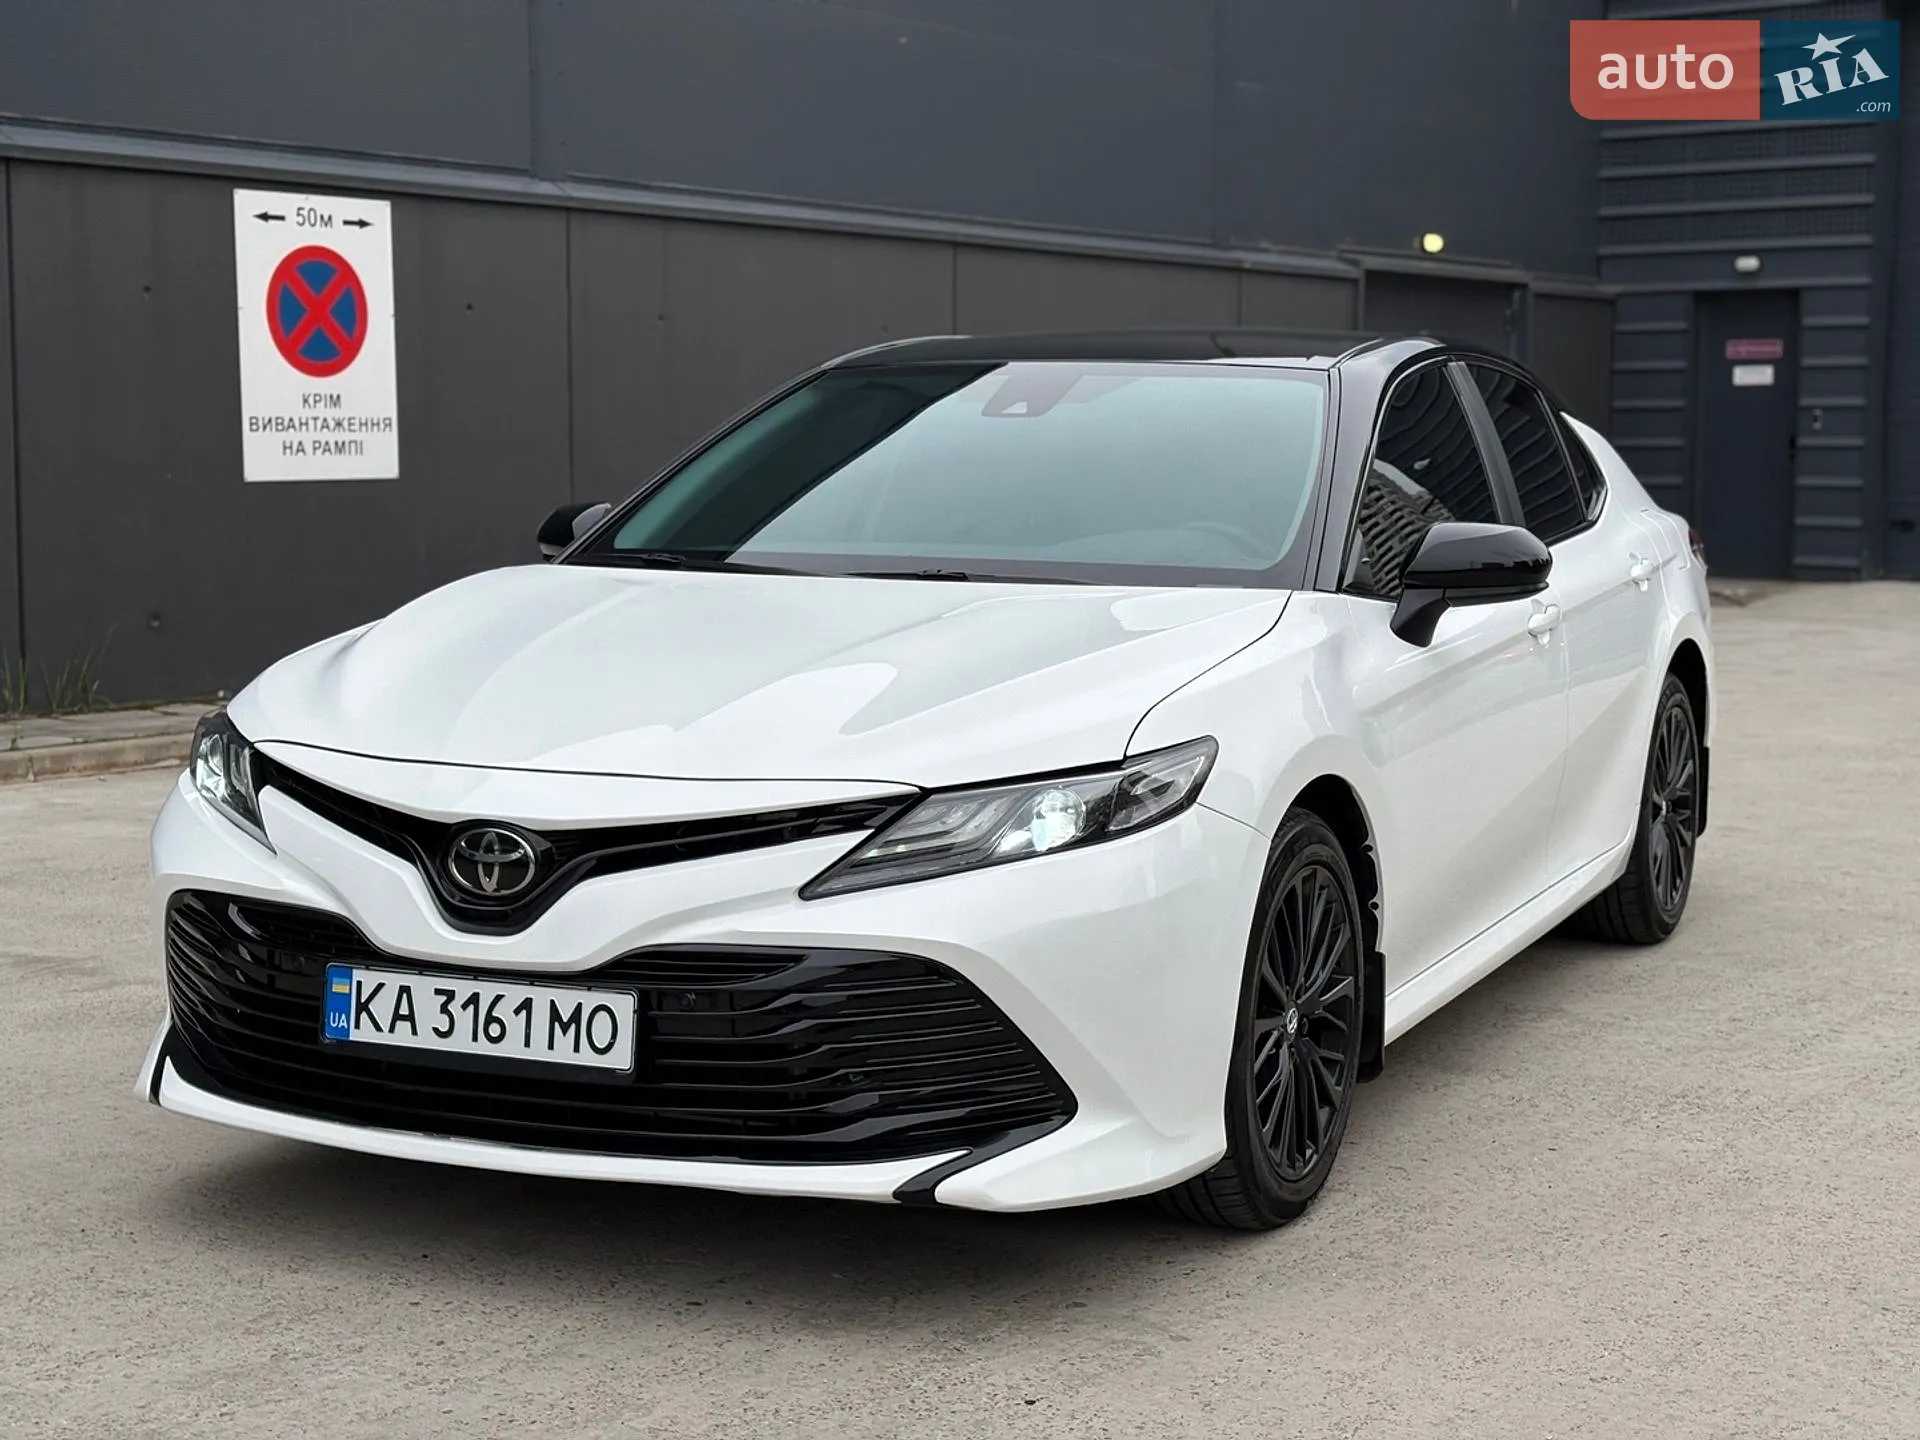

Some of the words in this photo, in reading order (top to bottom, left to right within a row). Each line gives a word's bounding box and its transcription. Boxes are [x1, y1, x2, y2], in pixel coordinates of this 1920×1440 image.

[302, 393, 342, 409] КРІМ
[249, 416, 393, 433] ВИВАНТАЖЕННЯ
[282, 440, 310, 456] НА
[312, 440, 364, 456] РАМПІ
[330, 1011, 348, 1029] UA
[353, 980, 418, 1037] KA
[431, 987, 535, 1048] 3161
[547, 998, 619, 1056] MO
